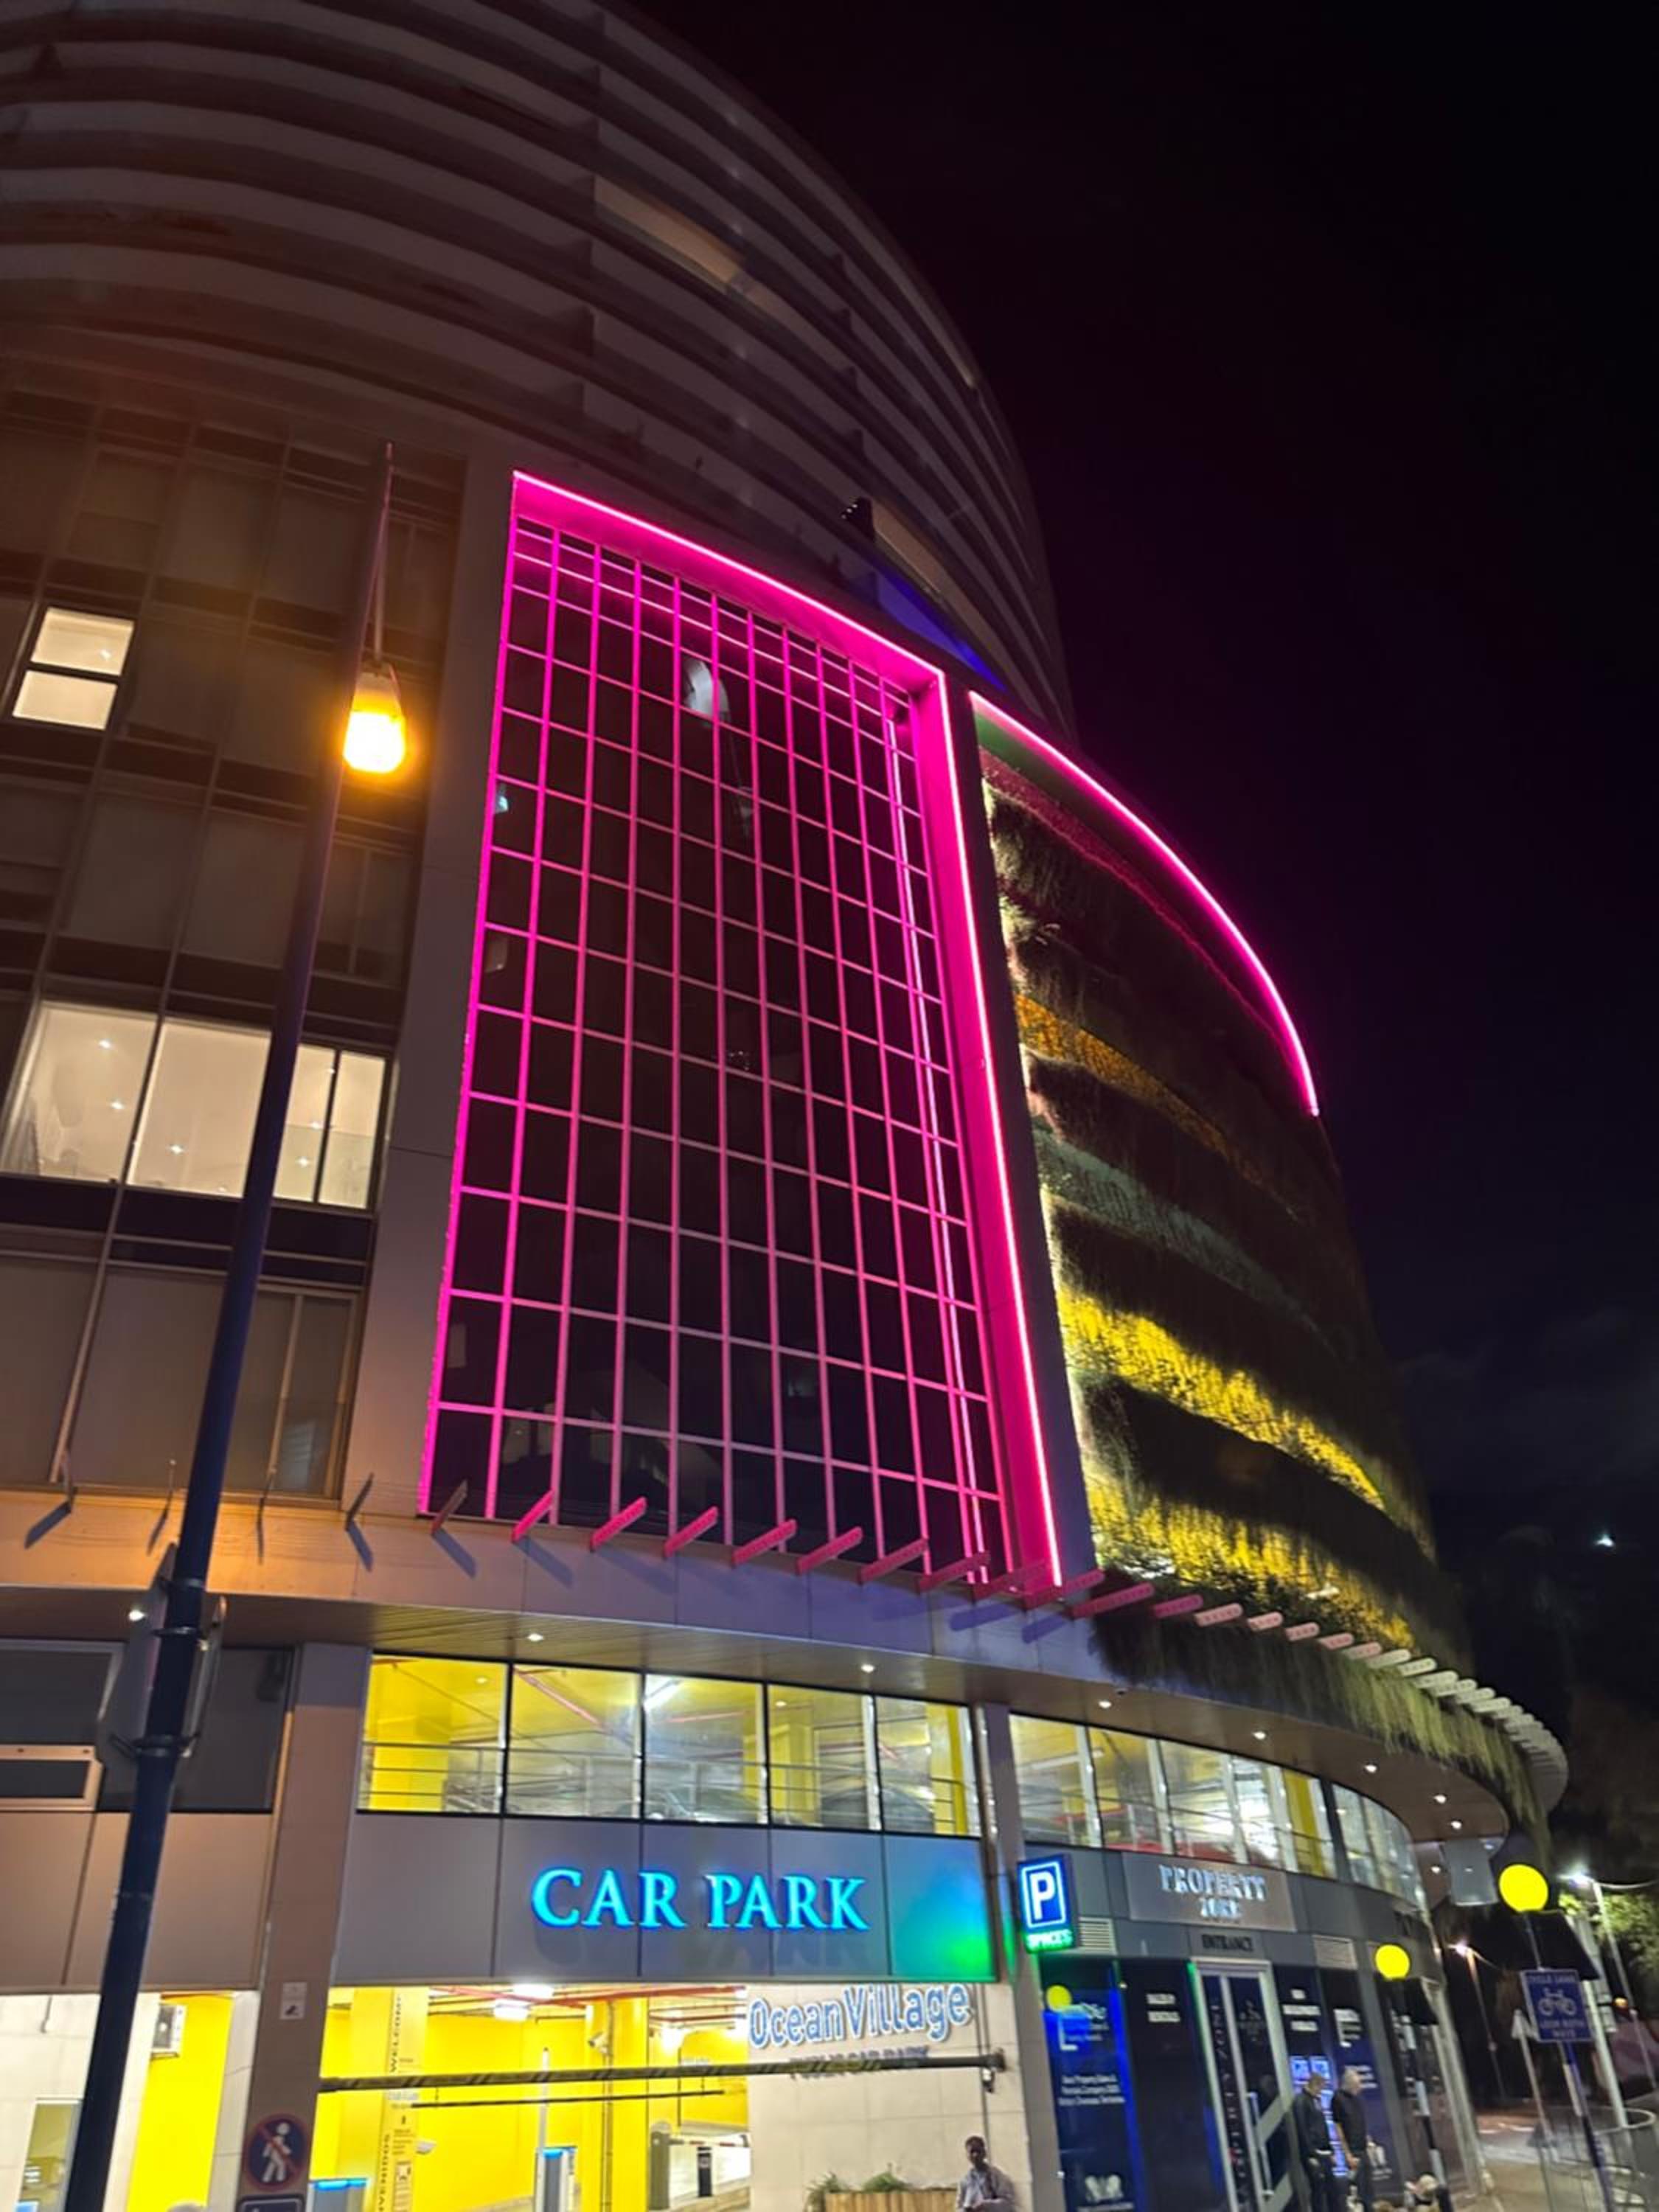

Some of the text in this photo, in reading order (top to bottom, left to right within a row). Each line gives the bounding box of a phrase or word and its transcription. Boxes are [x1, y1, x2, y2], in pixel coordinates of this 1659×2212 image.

[531, 1866, 869, 1930] CAR PARK
[1029, 1871, 1056, 1921] P
[1158, 1864, 1266, 1901] PROPERTY
[1201, 1933, 1254, 1952] ENTRANCE
